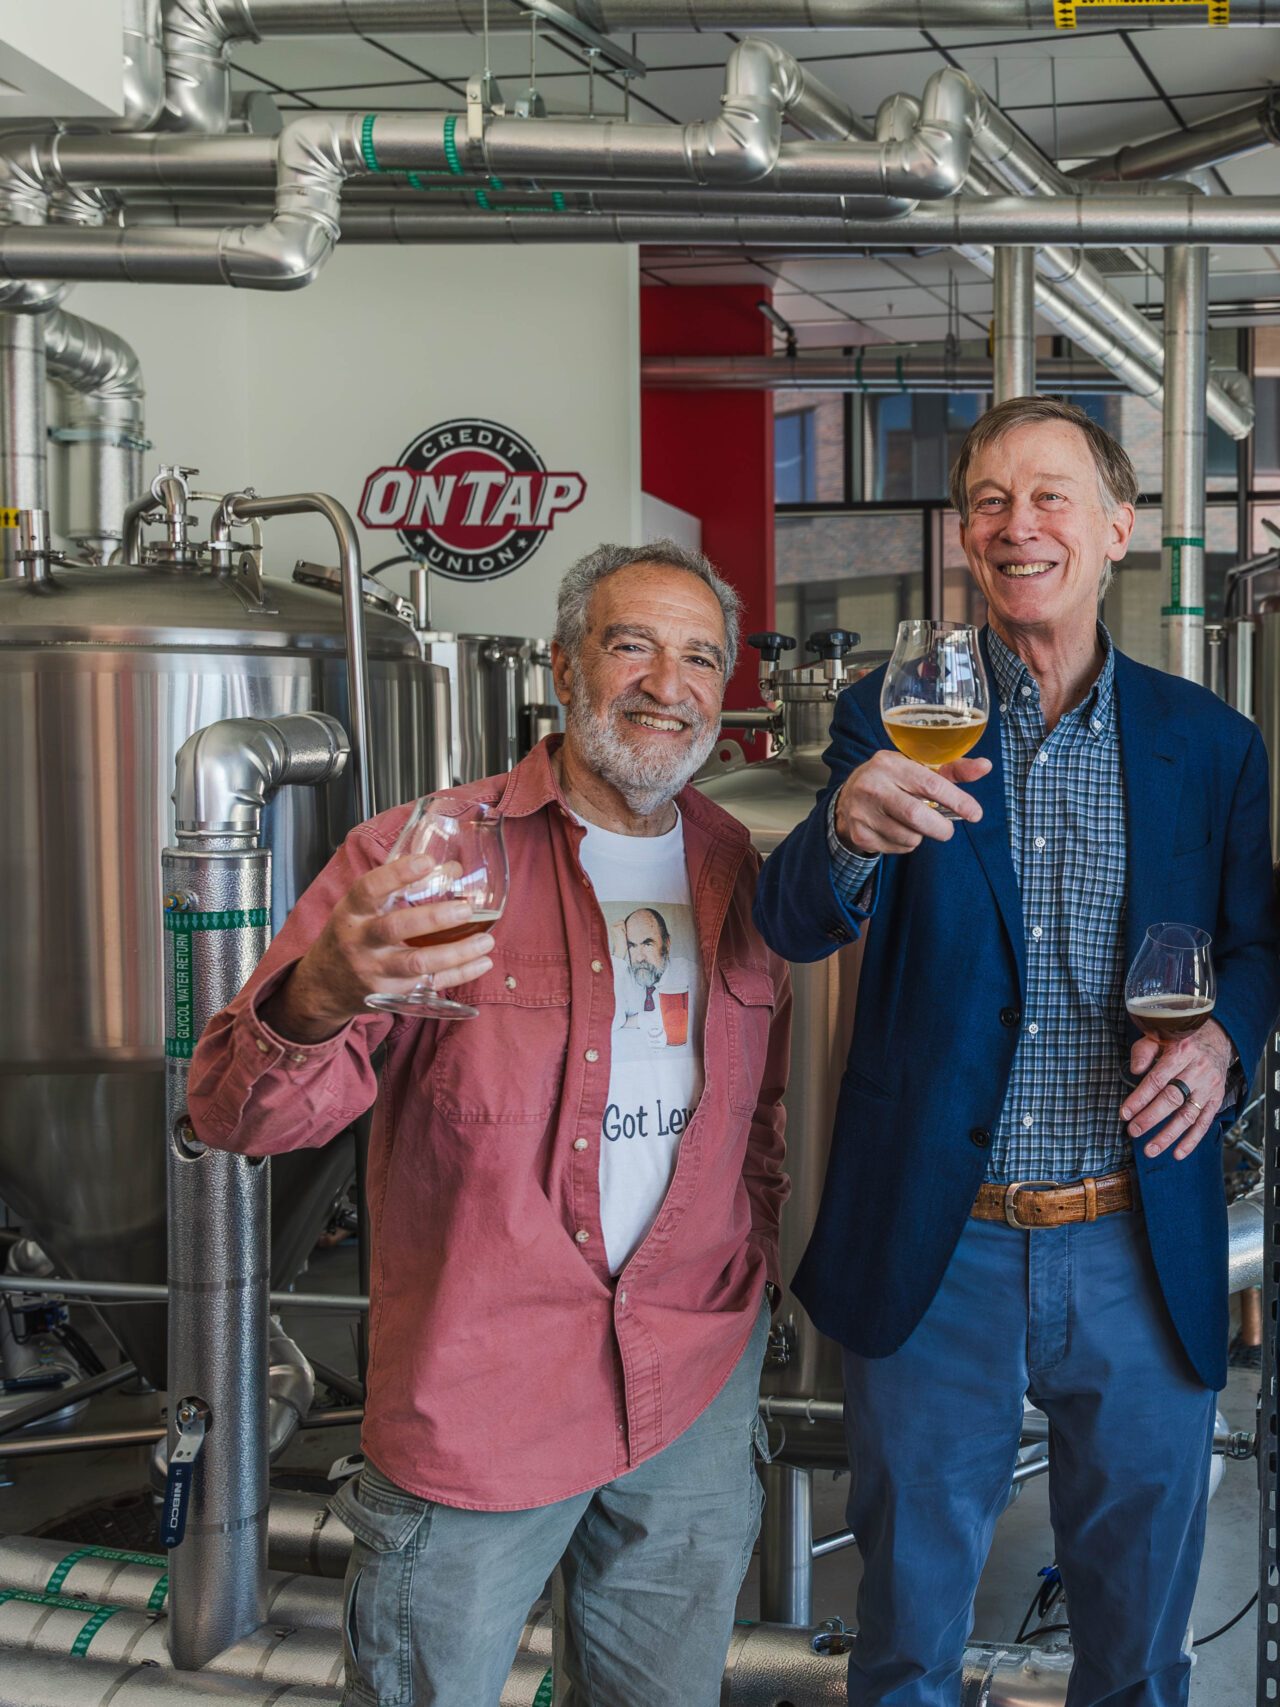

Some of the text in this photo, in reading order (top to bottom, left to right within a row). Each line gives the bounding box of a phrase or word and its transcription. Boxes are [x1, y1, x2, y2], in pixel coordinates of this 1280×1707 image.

[421, 428, 521, 458] CREDIT
[428, 547, 516, 572] UNION
[176, 933, 189, 1039] GLYCOL WATER RETURN
[602, 1104, 648, 1141] Got
[170, 1482, 182, 1528] NIBCO
